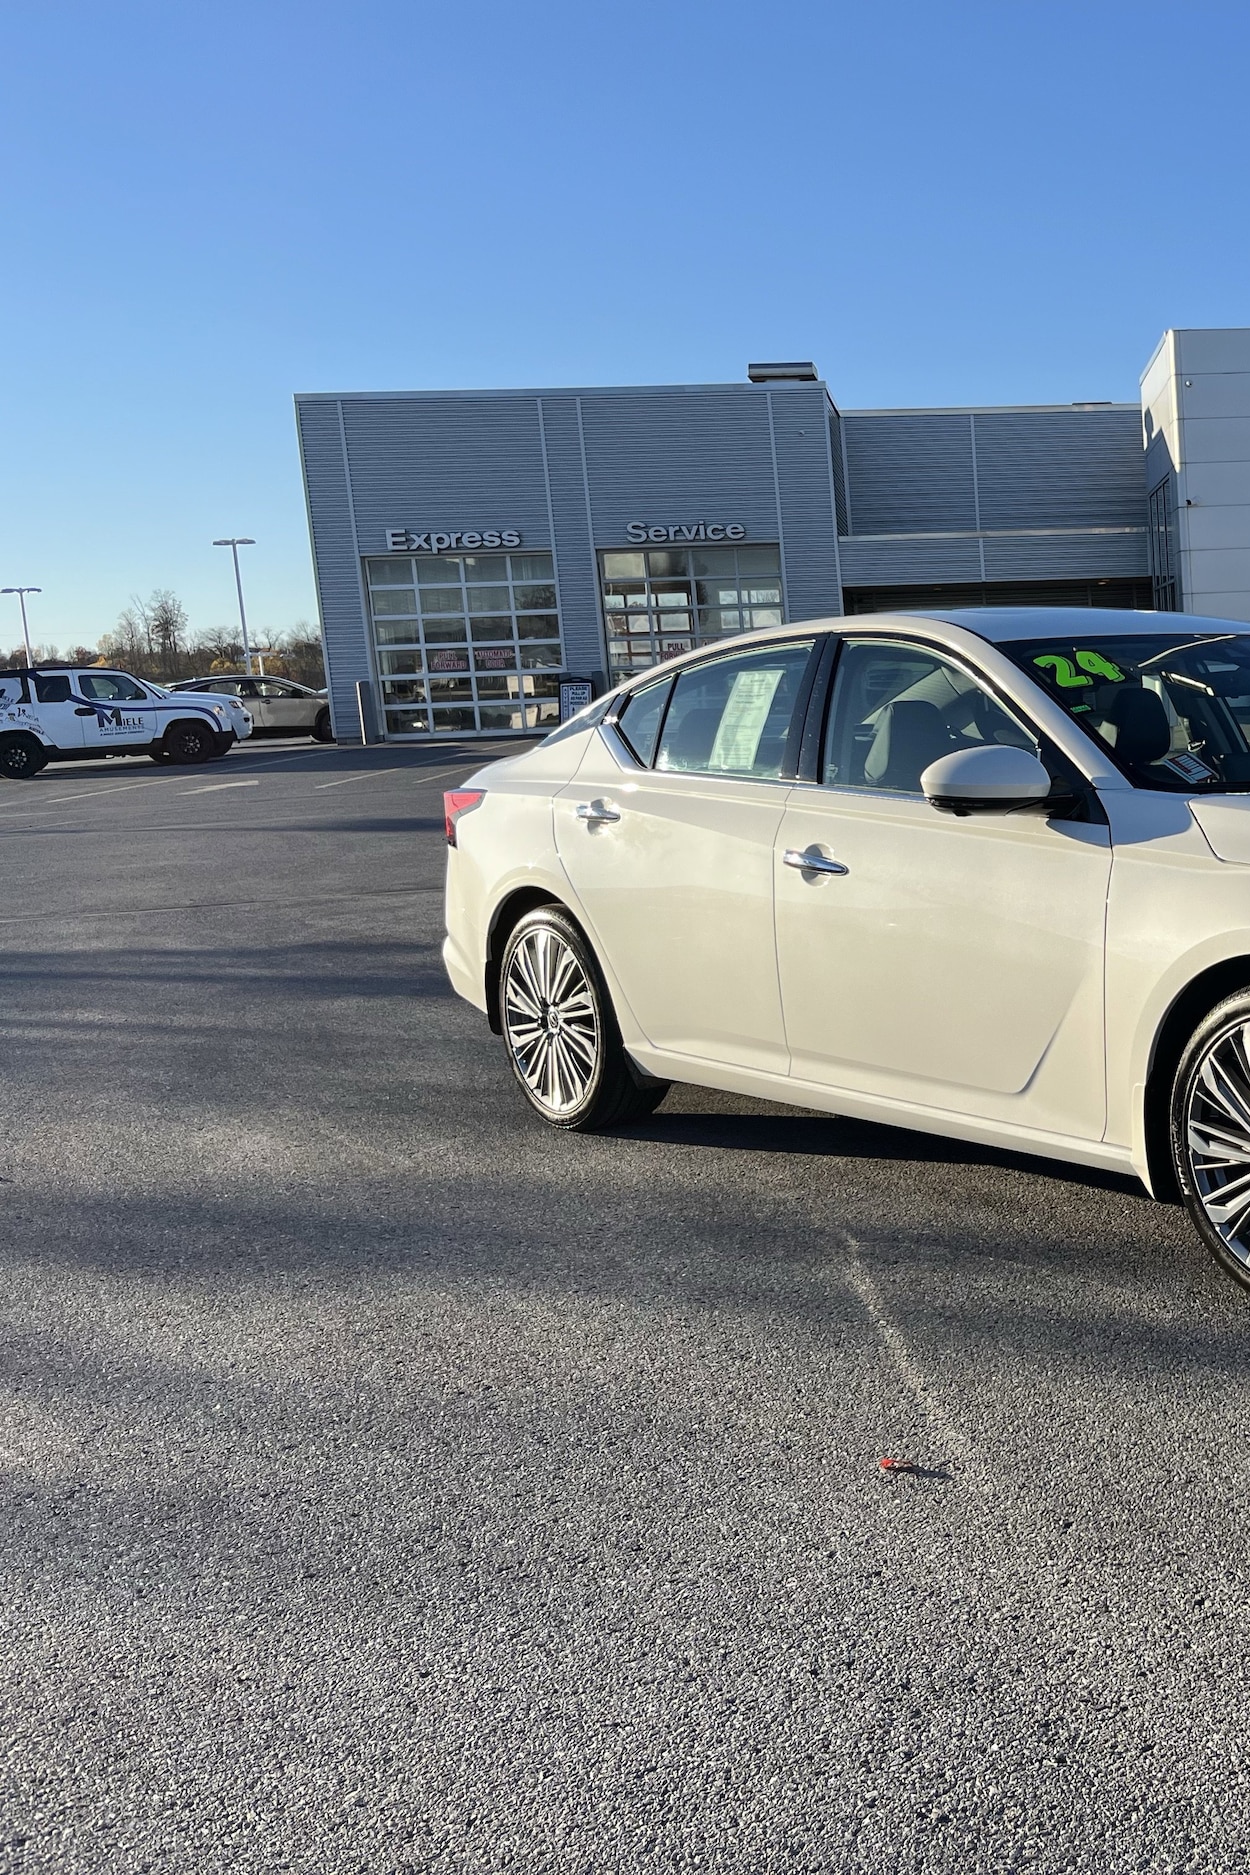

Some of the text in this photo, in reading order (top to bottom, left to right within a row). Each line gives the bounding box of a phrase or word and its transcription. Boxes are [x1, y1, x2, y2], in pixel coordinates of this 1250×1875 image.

[385, 528, 521, 554] Express
[626, 520, 746, 544] Service
[437, 650, 458, 661] PULL
[667, 643, 686, 651] PULL
[430, 660, 467, 671] FORWARD
[1033, 651, 1126, 688] 24
[97, 708, 144, 728] MIELE
